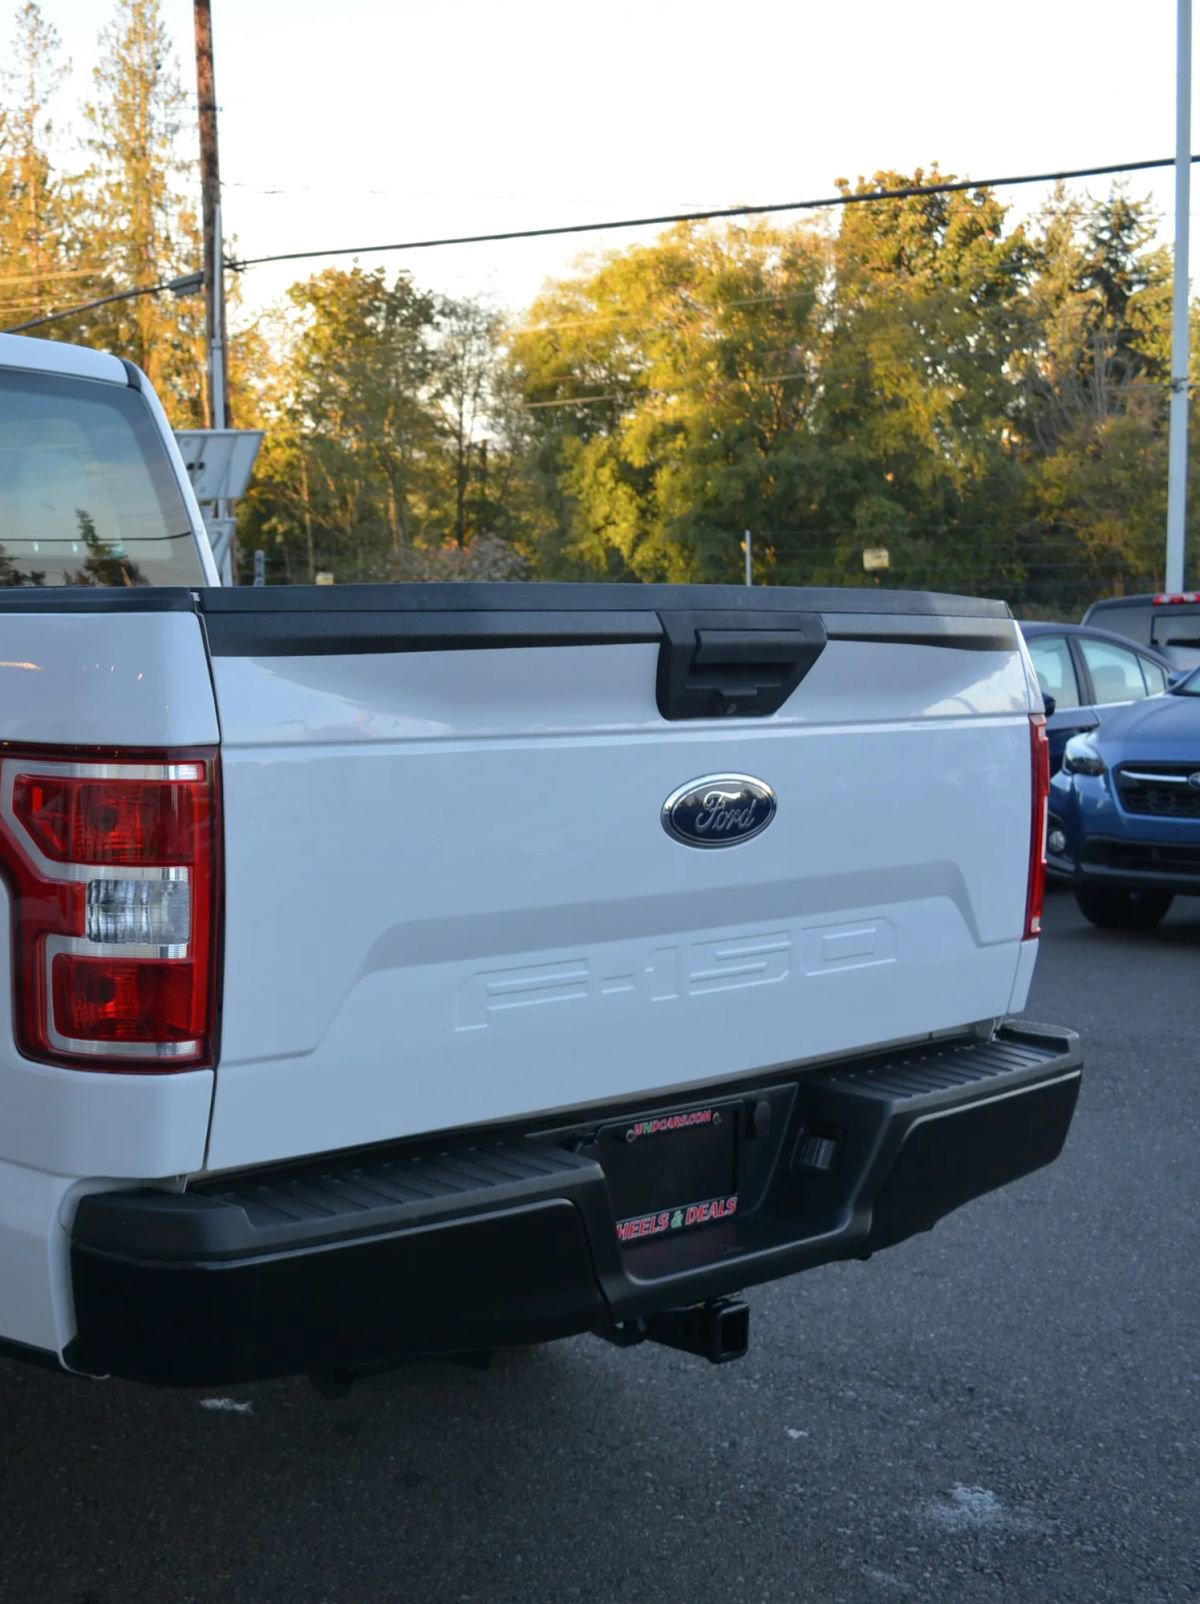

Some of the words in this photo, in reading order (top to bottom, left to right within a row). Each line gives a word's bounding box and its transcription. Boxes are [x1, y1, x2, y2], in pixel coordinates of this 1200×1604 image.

[695, 790, 757, 833] Ford
[453, 916, 897, 1032] F-150
[616, 1211, 669, 1241] HEELS
[670, 1210, 684, 1229] &
[685, 1196, 738, 1226] DEALS
